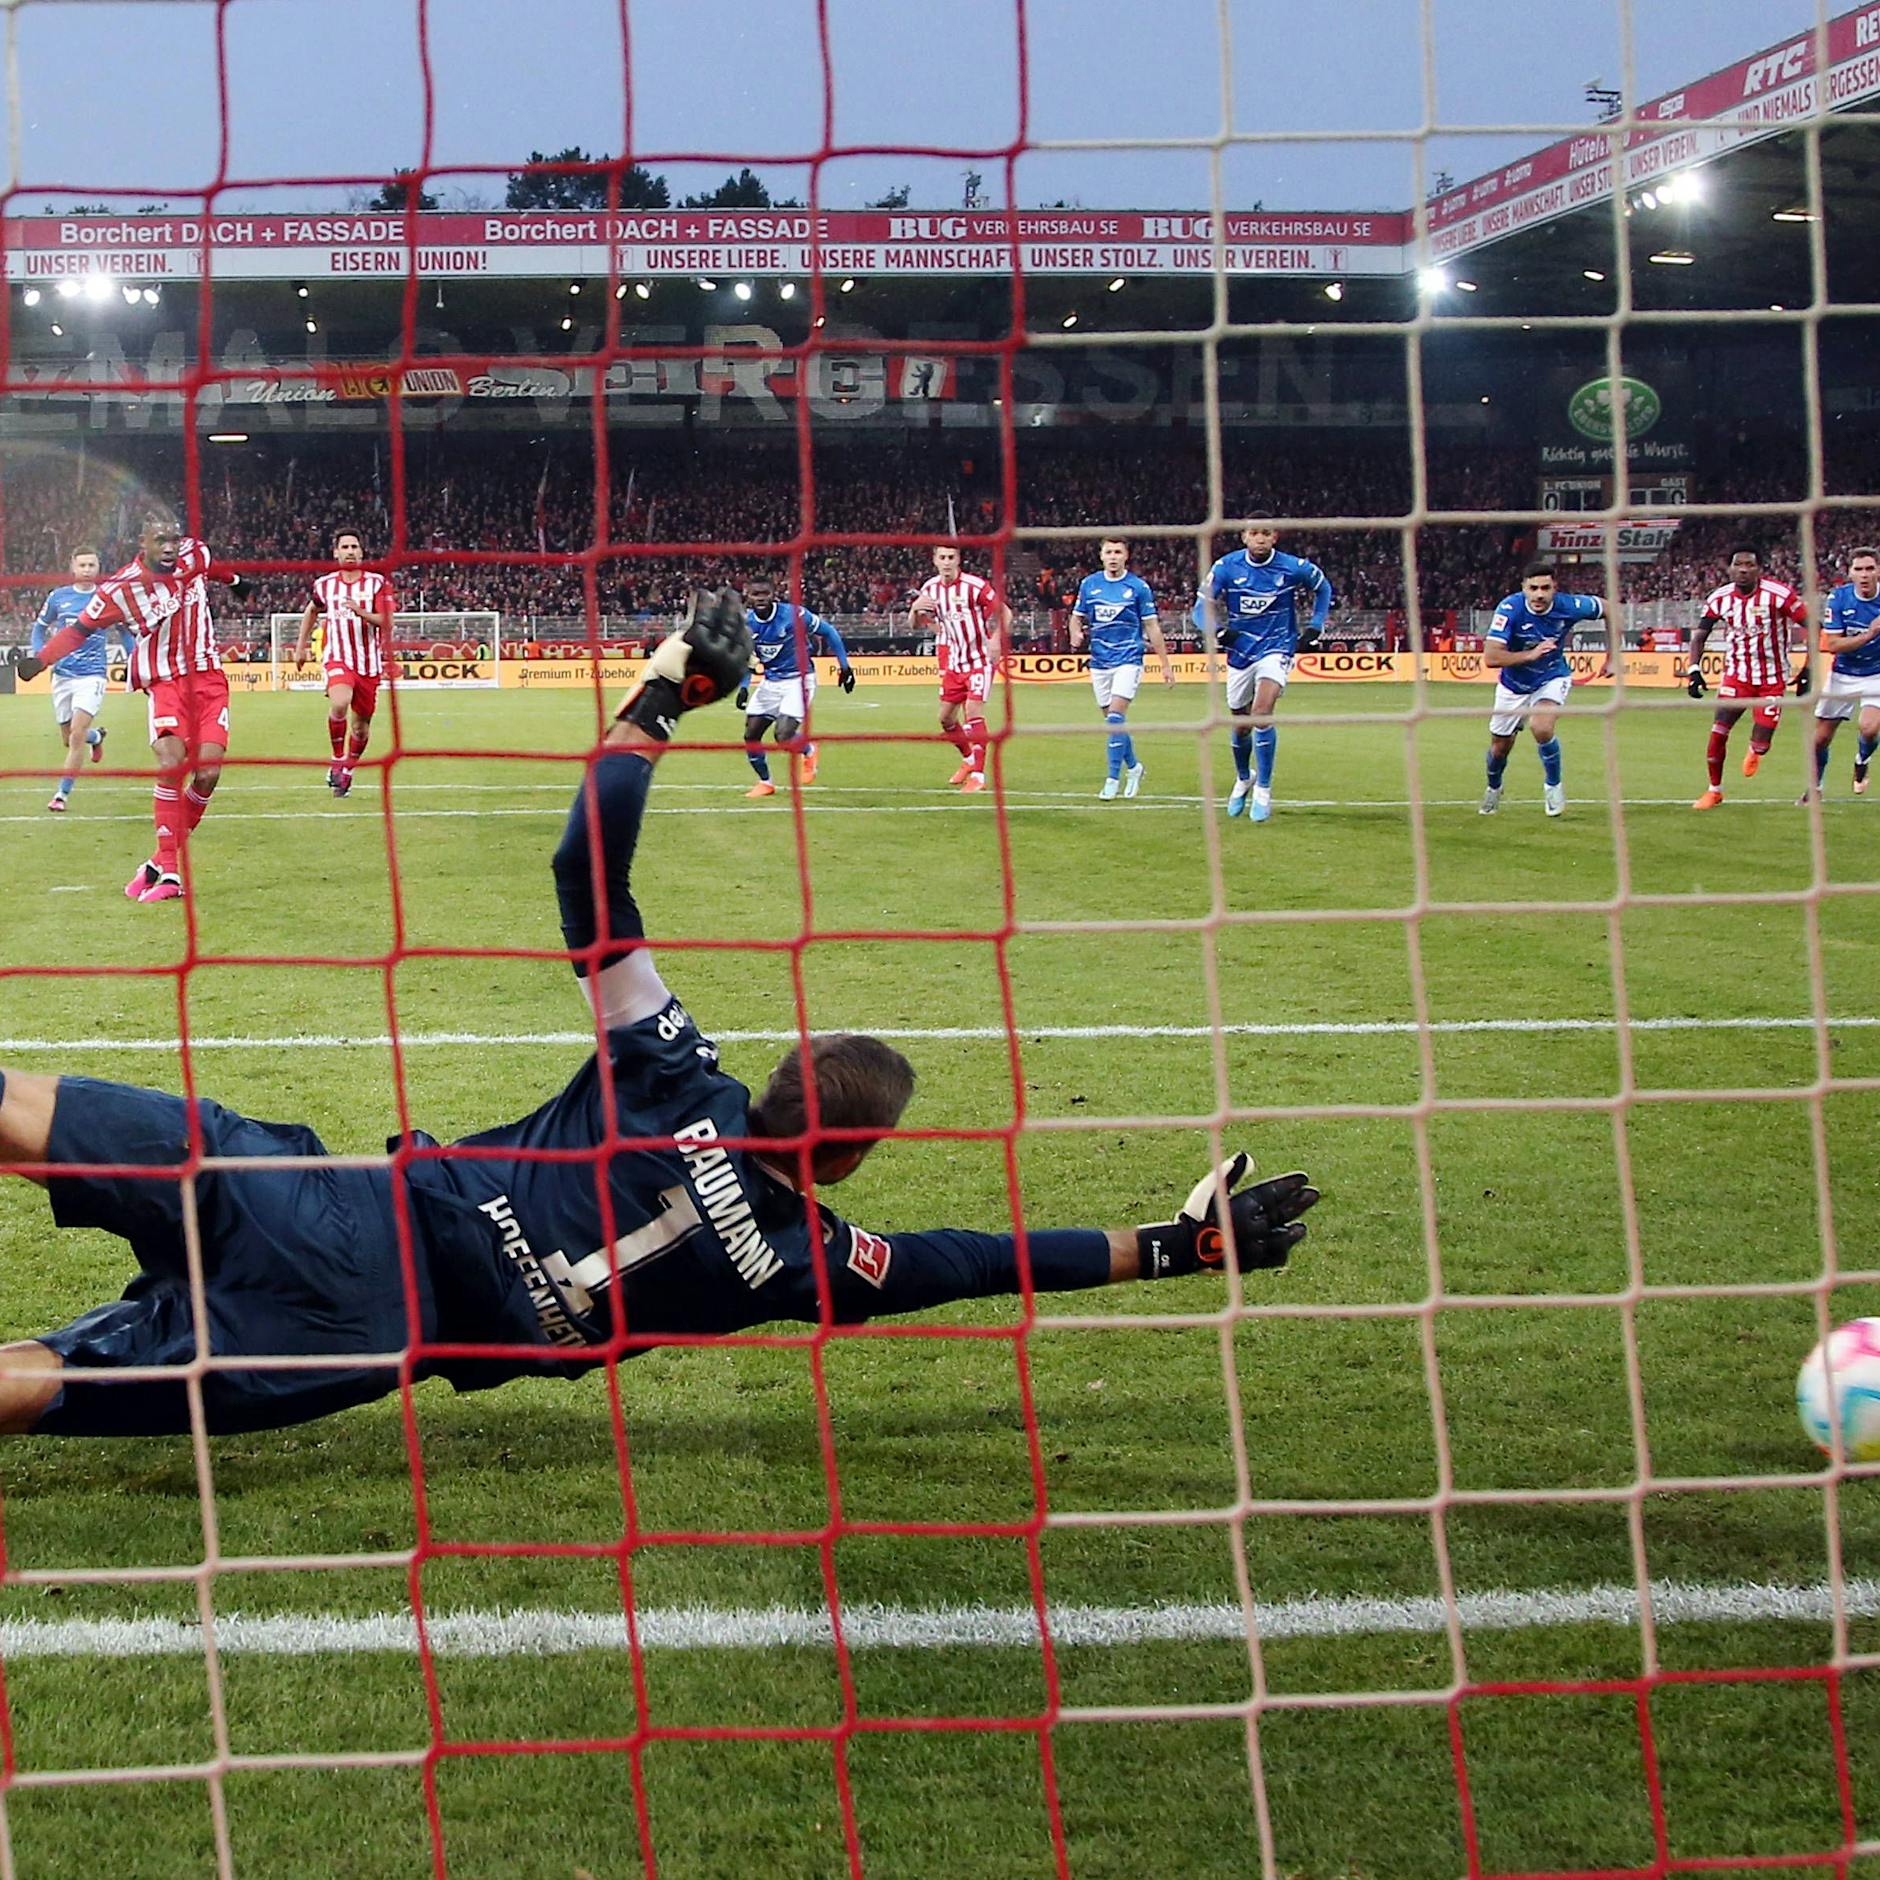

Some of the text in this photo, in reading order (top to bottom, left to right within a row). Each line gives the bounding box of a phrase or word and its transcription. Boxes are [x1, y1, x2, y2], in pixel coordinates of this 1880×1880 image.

[1856, 9, 1880, 47] RE
[1743, 41, 1808, 96] RTC
[1763, 84, 1811, 120] NIEMALS
[60, 222, 173, 243] Borchert
[181, 222, 253, 243] DACH
[284, 220, 405, 242] FASSADE
[484, 219, 597, 240] Borchert
[605, 219, 678, 240] DACH
[708, 218, 828, 239] FASSADE
[888, 216, 968, 240] BUG
[1100, 219, 1119, 236] SE
[1141, 216, 1372, 240] BUG VERKEHRSBAU SE
[26, 254, 89, 275] UNSER
[96, 252, 173, 274] VEREIN.
[330, 250, 487, 272] EISERN UNION!
[646, 249, 722, 270] UNSERE
[727, 249, 787, 270] LIEBE.
[801, 249, 876, 269] UNSERE
[1031, 248, 1094, 268] UNSER
[1100, 248, 1164, 269] STOLZ.
[1173, 248, 1235, 269] UNSR
[1243, 249, 1316, 270] VEREIN.
[247, 379, 337, 404] Union
[1097, 607, 1117, 618] SAP
[1241, 599, 1267, 610] SAP
[402, 663, 481, 680] LOCK
[521, 667, 636, 680] Premium IT-Zubehör
[883, 664, 939, 676] IT-Zubehö
[1297, 656, 1394, 673] eLOCK
[1569, 655, 1593, 673] OCK
[969, 673, 984, 691] 19
[672, 1117, 785, 1290] BAUMANN
[541, 1184, 704, 1318] 1
